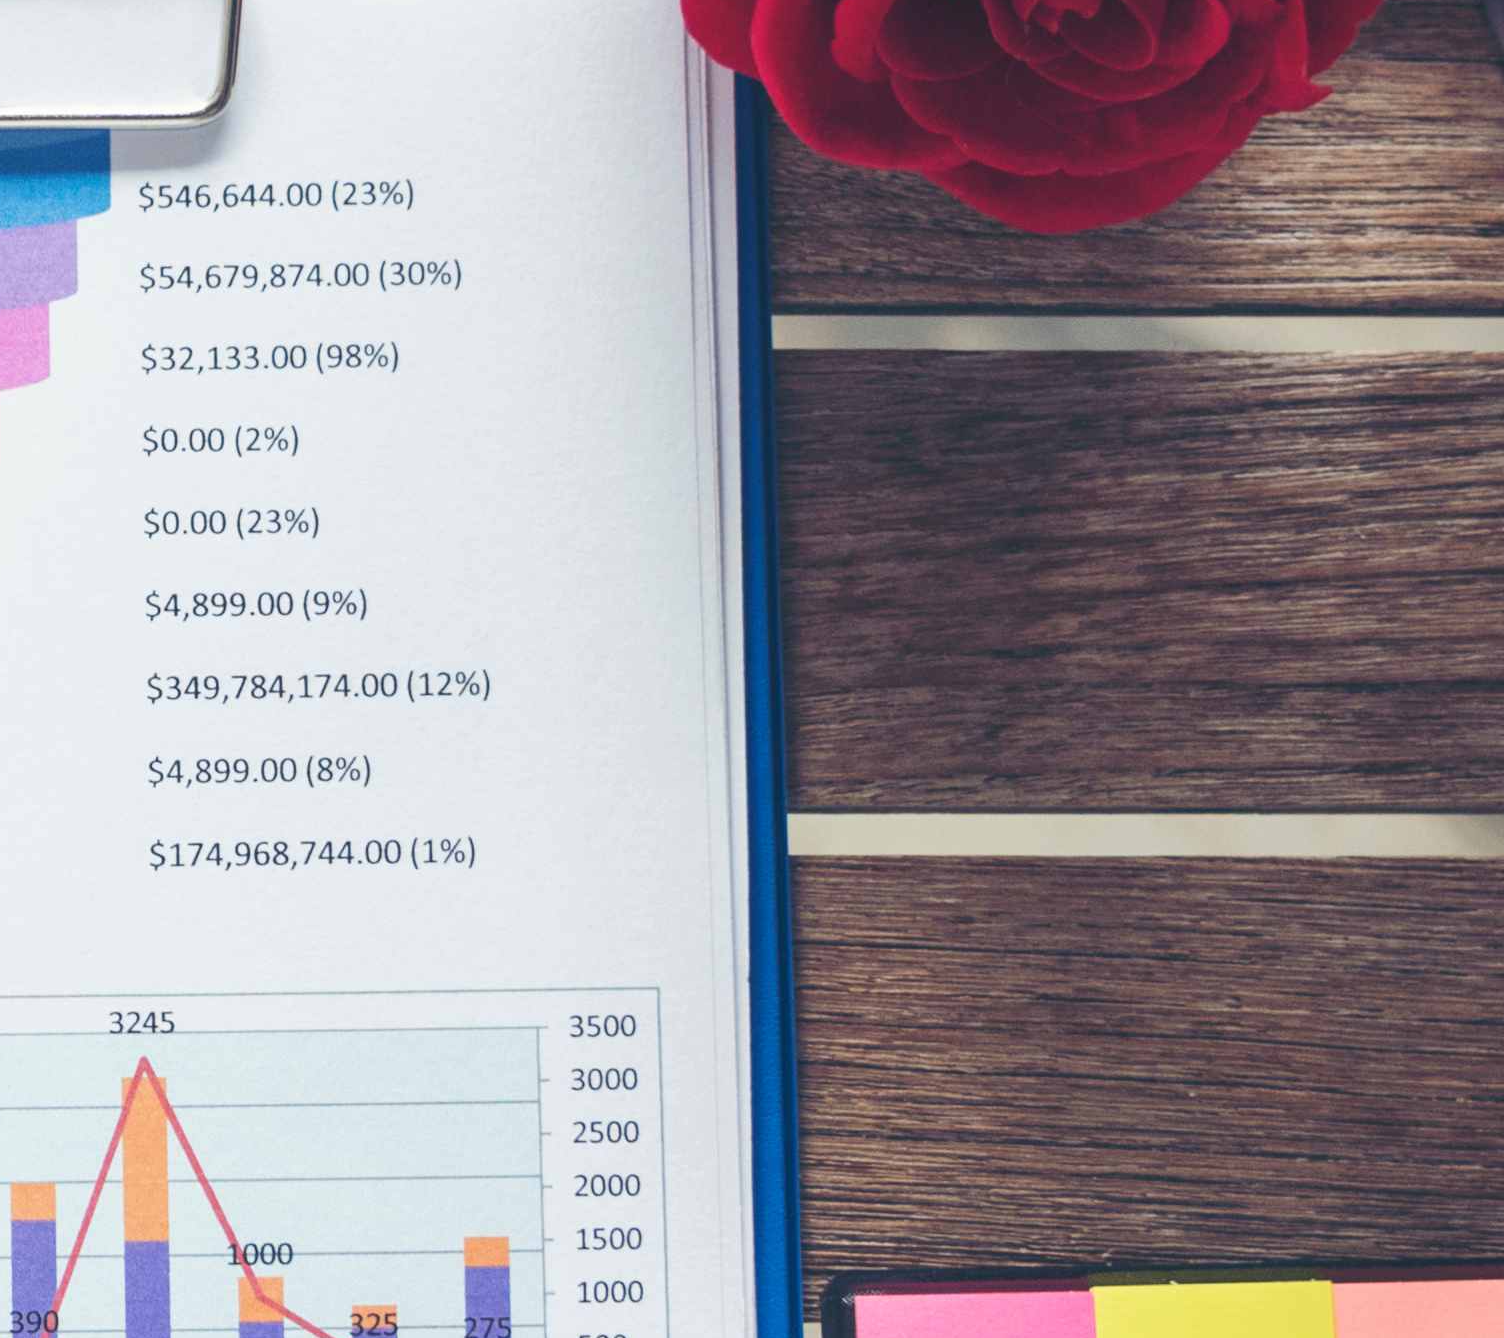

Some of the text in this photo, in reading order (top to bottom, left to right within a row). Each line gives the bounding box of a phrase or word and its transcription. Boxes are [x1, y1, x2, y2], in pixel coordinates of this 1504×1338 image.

[139, 179, 413, 212] $546,644.00 (23%)
[140, 259, 461, 293] $54,679,874.00 (30%)
[142, 342, 399, 374] $32,133.00 (98%)
[143, 425, 299, 457] $0.00 (2%)
[145, 507, 319, 540] $0.00 (23%)
[146, 589, 367, 621] $4,899.00 (9%)
[148, 669, 490, 704] $349,784,174.00 (12%)
[149, 755, 371, 788] $4,899.00 (8%)
[150, 837, 475, 871] $174,968,744.00 (1%)
[109, 1011, 175, 1034] 3245
[570, 1015, 636, 1038] 3500
[572, 1068, 638, 1091] 3000
[574, 1121, 639, 1143] 2500
[575, 1174, 641, 1197] 2000
[577, 1227, 642, 1250] 1500
[226, 1242, 294, 1267] 1000
[578, 1280, 644, 1303] 1000
[8, 1311, 60, 1334] 390
[348, 1312, 399, 1337] 325
[462, 1318, 511, 1338] 275
